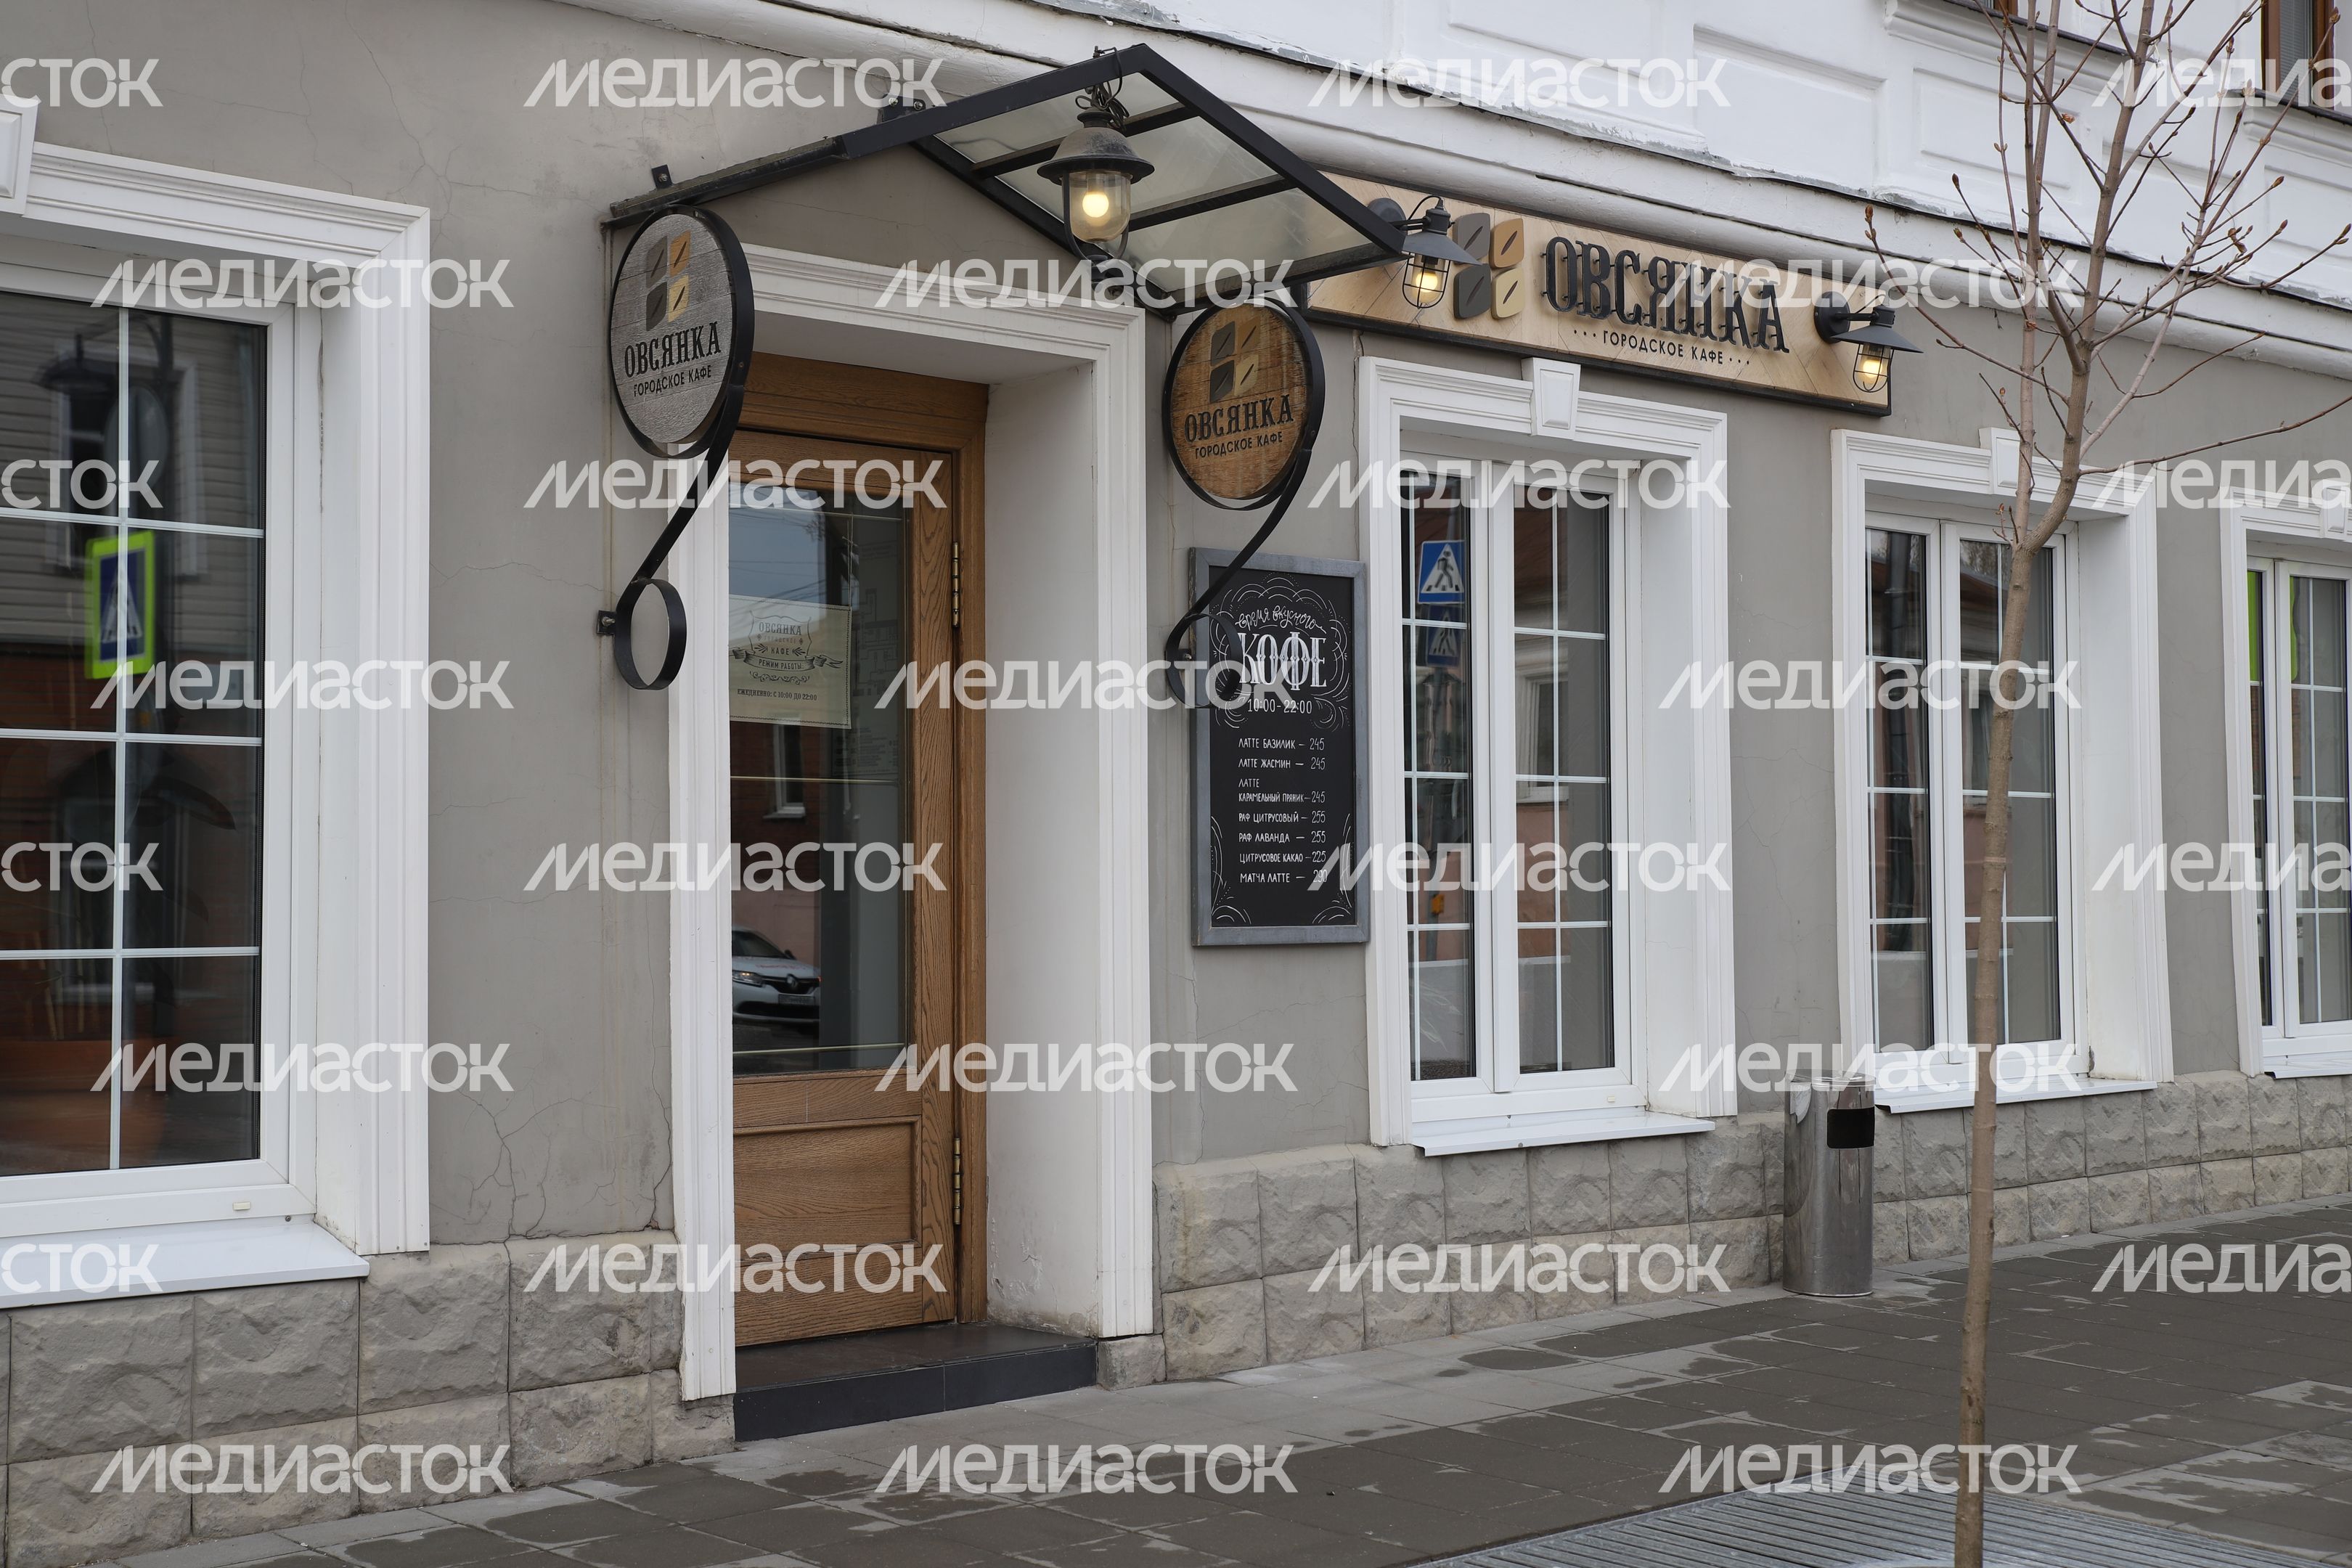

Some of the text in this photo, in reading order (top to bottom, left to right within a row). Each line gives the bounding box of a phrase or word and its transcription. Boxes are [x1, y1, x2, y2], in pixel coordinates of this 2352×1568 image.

[1544, 237, 1790, 354] ОВСЯНКА
[624, 321, 722, 377] ОВСЯНКА
[1603, 330, 1723, 364] ГОРОДСКОЕ КАФЕ
[633, 364, 712, 397] ГОРОДСКОЕ КАФЕ
[1184, 393, 1294, 443] ОВСЯНКА
[1194, 431, 1283, 460] ГОРОДСКОЕ КАФЕ
[759, 621, 802, 636] ОВСЯНКА
[771, 646, 790, 655] КАФЕ
[759, 659, 779, 669] РЕЖИМ
[1237, 631, 1327, 691] КОФЕ
[1238, 738, 1325, 751] ЛАТТЕ БАЗИЛИК 245
[1238, 756, 1326, 770] ЛАТТЕ ЖАСМИН 245
[1238, 778, 1259, 788] ЛАТТЕ
[1238, 791, 1281, 802] КАРАМЕЛЬНЫЙ
[1311, 791, 1326, 803] 245
[1238, 810, 1326, 824] РАФ ЦИТРУСОВЫЙ 255
[1238, 830, 1326, 844] РАФ ЛАВАНДА 255
[1239, 850, 1326, 865] ЦИТРУСОВОЕ КАКАО 225
[1240, 869, 1328, 883] МАТЧА ЛАТТЕ 290
